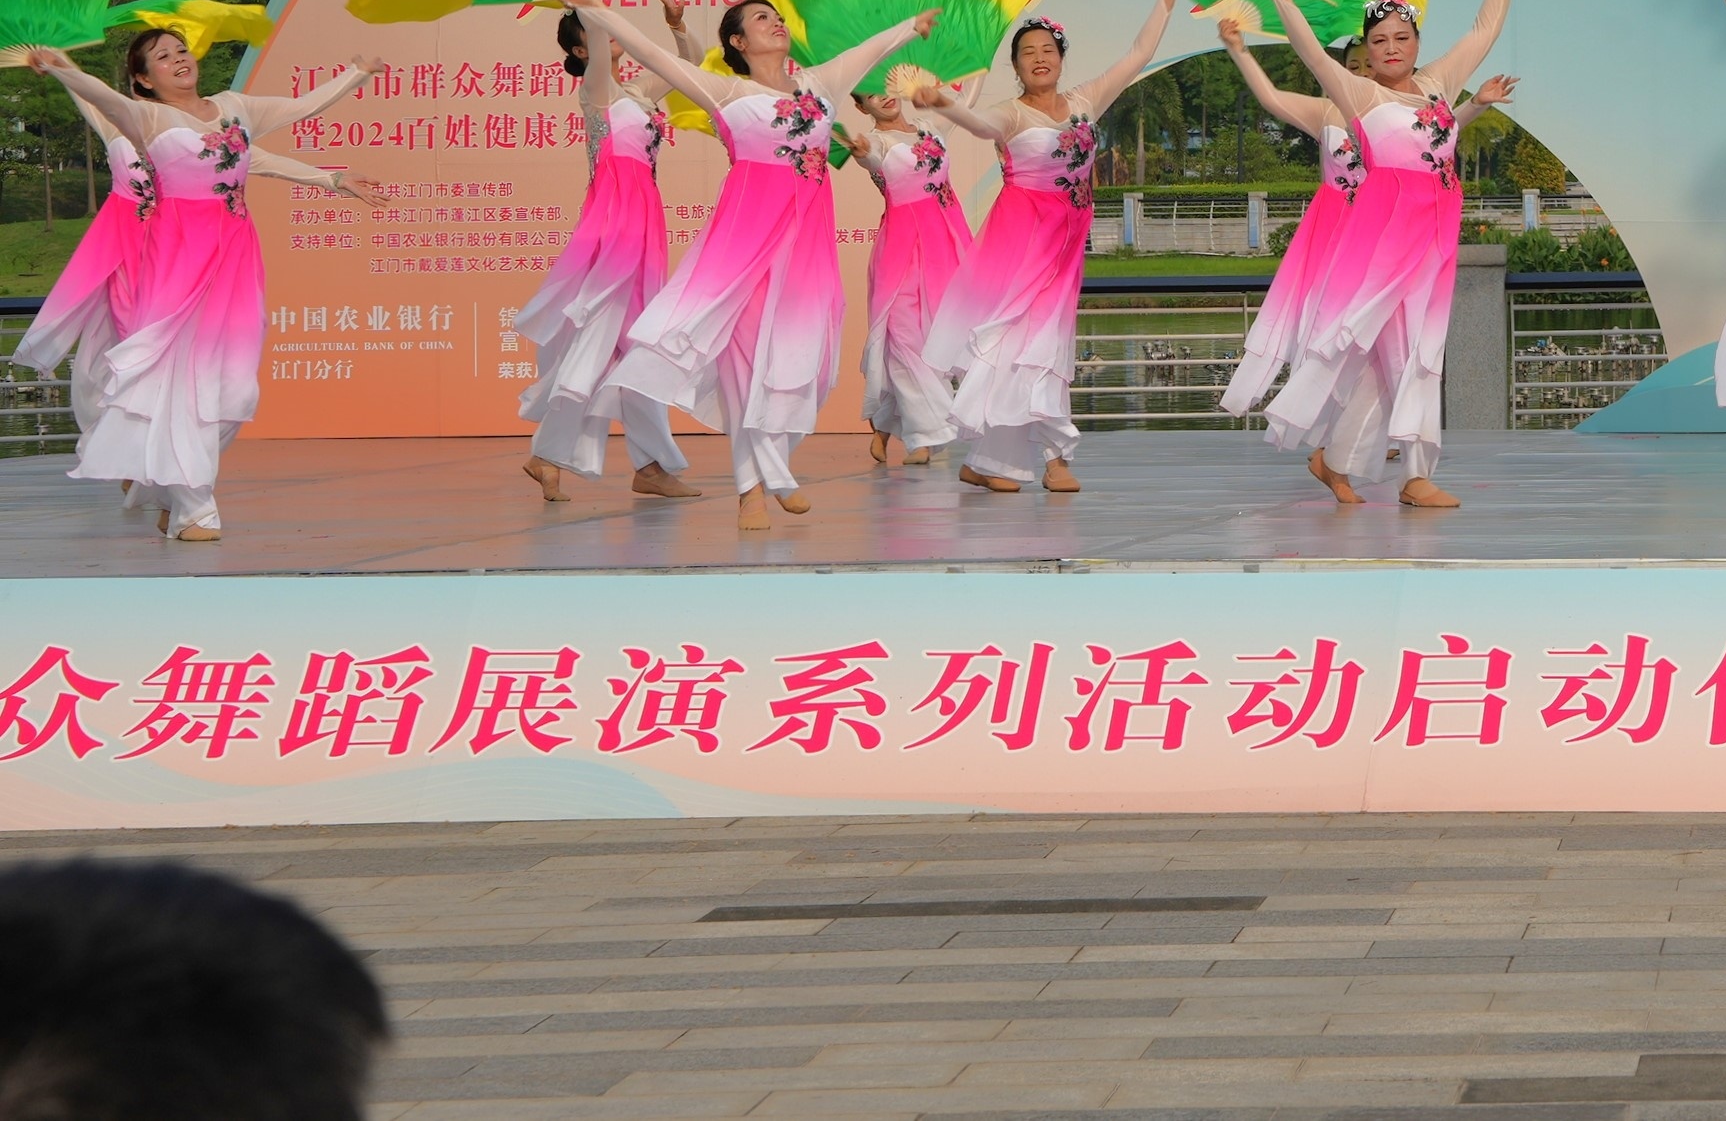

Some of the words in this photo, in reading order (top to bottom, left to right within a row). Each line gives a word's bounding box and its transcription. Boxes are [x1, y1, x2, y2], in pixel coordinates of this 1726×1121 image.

[291, 61, 585, 100] 江市群众舞蹈
[271, 304, 455, 333] 中国农业银行
[271, 342, 359, 352] AGRICULTURAL
[364, 341, 395, 351] BANK
[400, 341, 414, 350] OF
[419, 341, 454, 350] CHINA
[499, 330, 520, 352] 富
[271, 359, 354, 380] 江门分行
[498, 361, 539, 379] 荣获
